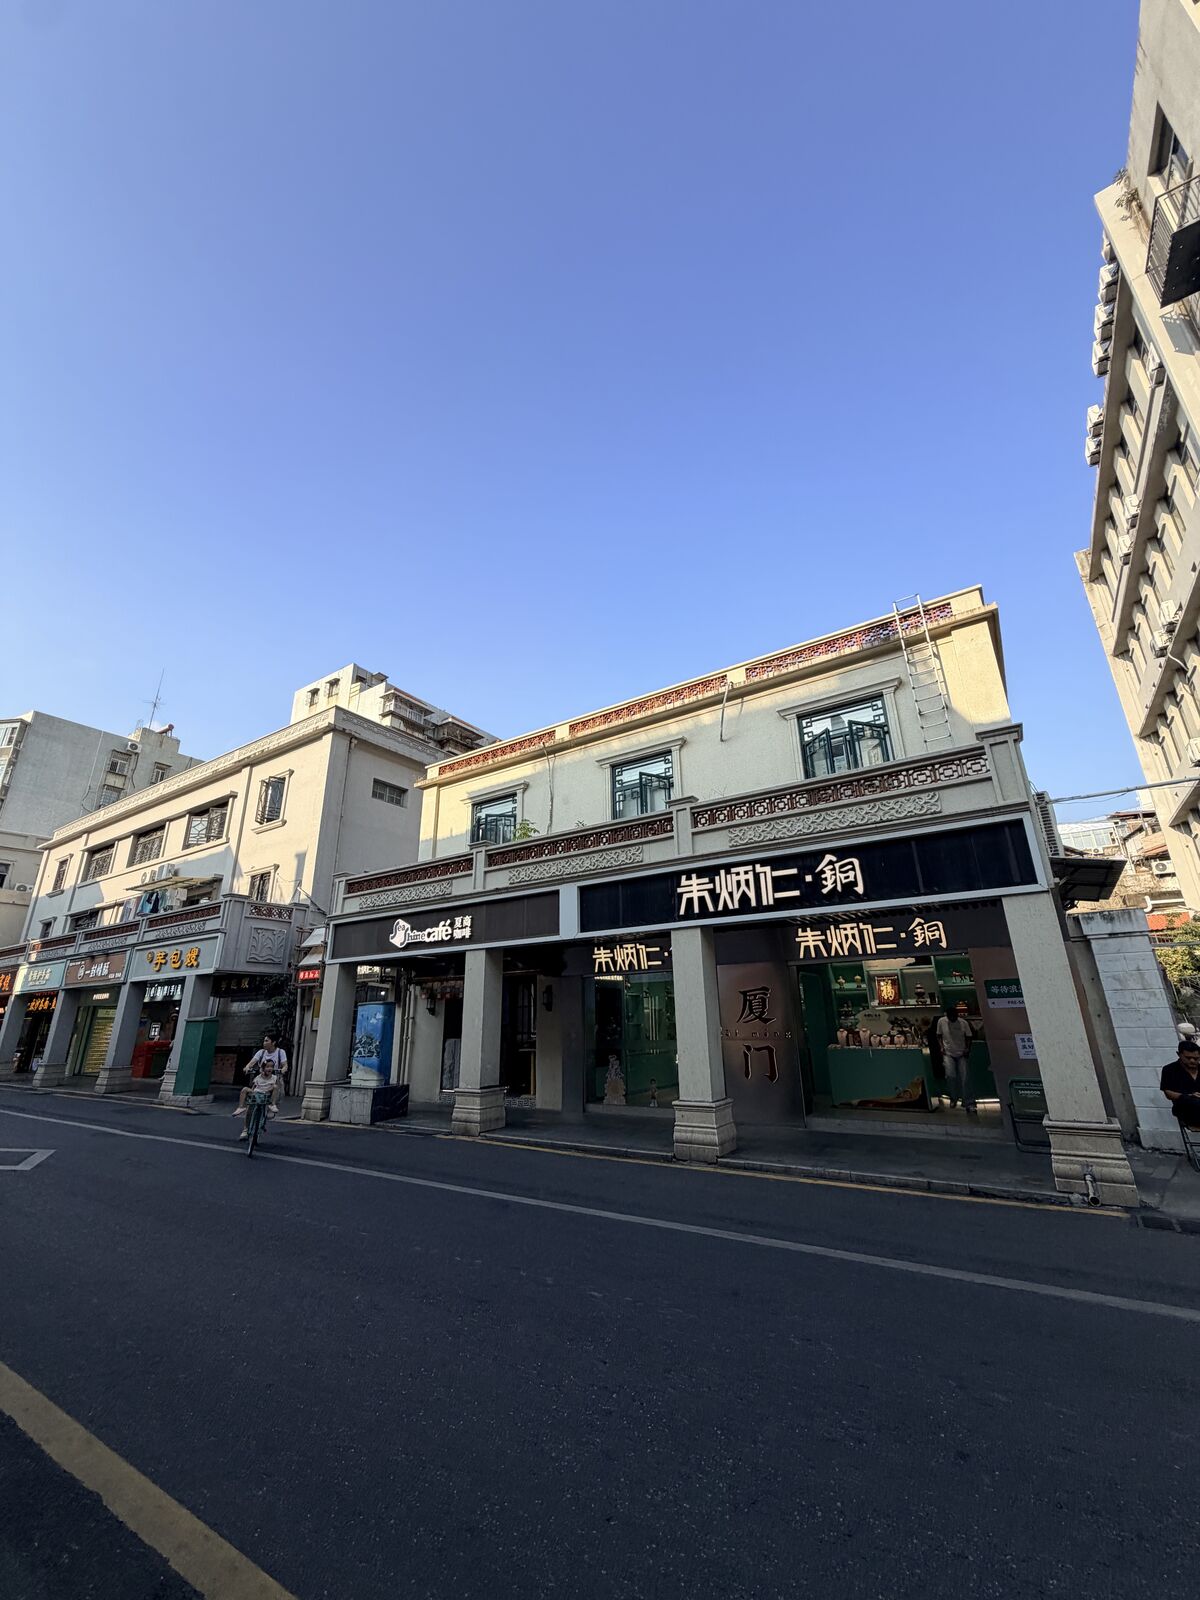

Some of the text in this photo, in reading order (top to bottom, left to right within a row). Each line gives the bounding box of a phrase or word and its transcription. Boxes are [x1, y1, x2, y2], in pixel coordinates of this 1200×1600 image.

[677, 854, 864, 915] 朱炳仁·銅
[425, 919, 452, 942] café
[454, 915, 472, 928] 夏商
[795, 917, 948, 959] 朱炳仁·銅
[592, 943, 673, 973] 朱炳仁·
[736, 986, 777, 1025] 厦
[743, 1044, 778, 1083] 门
